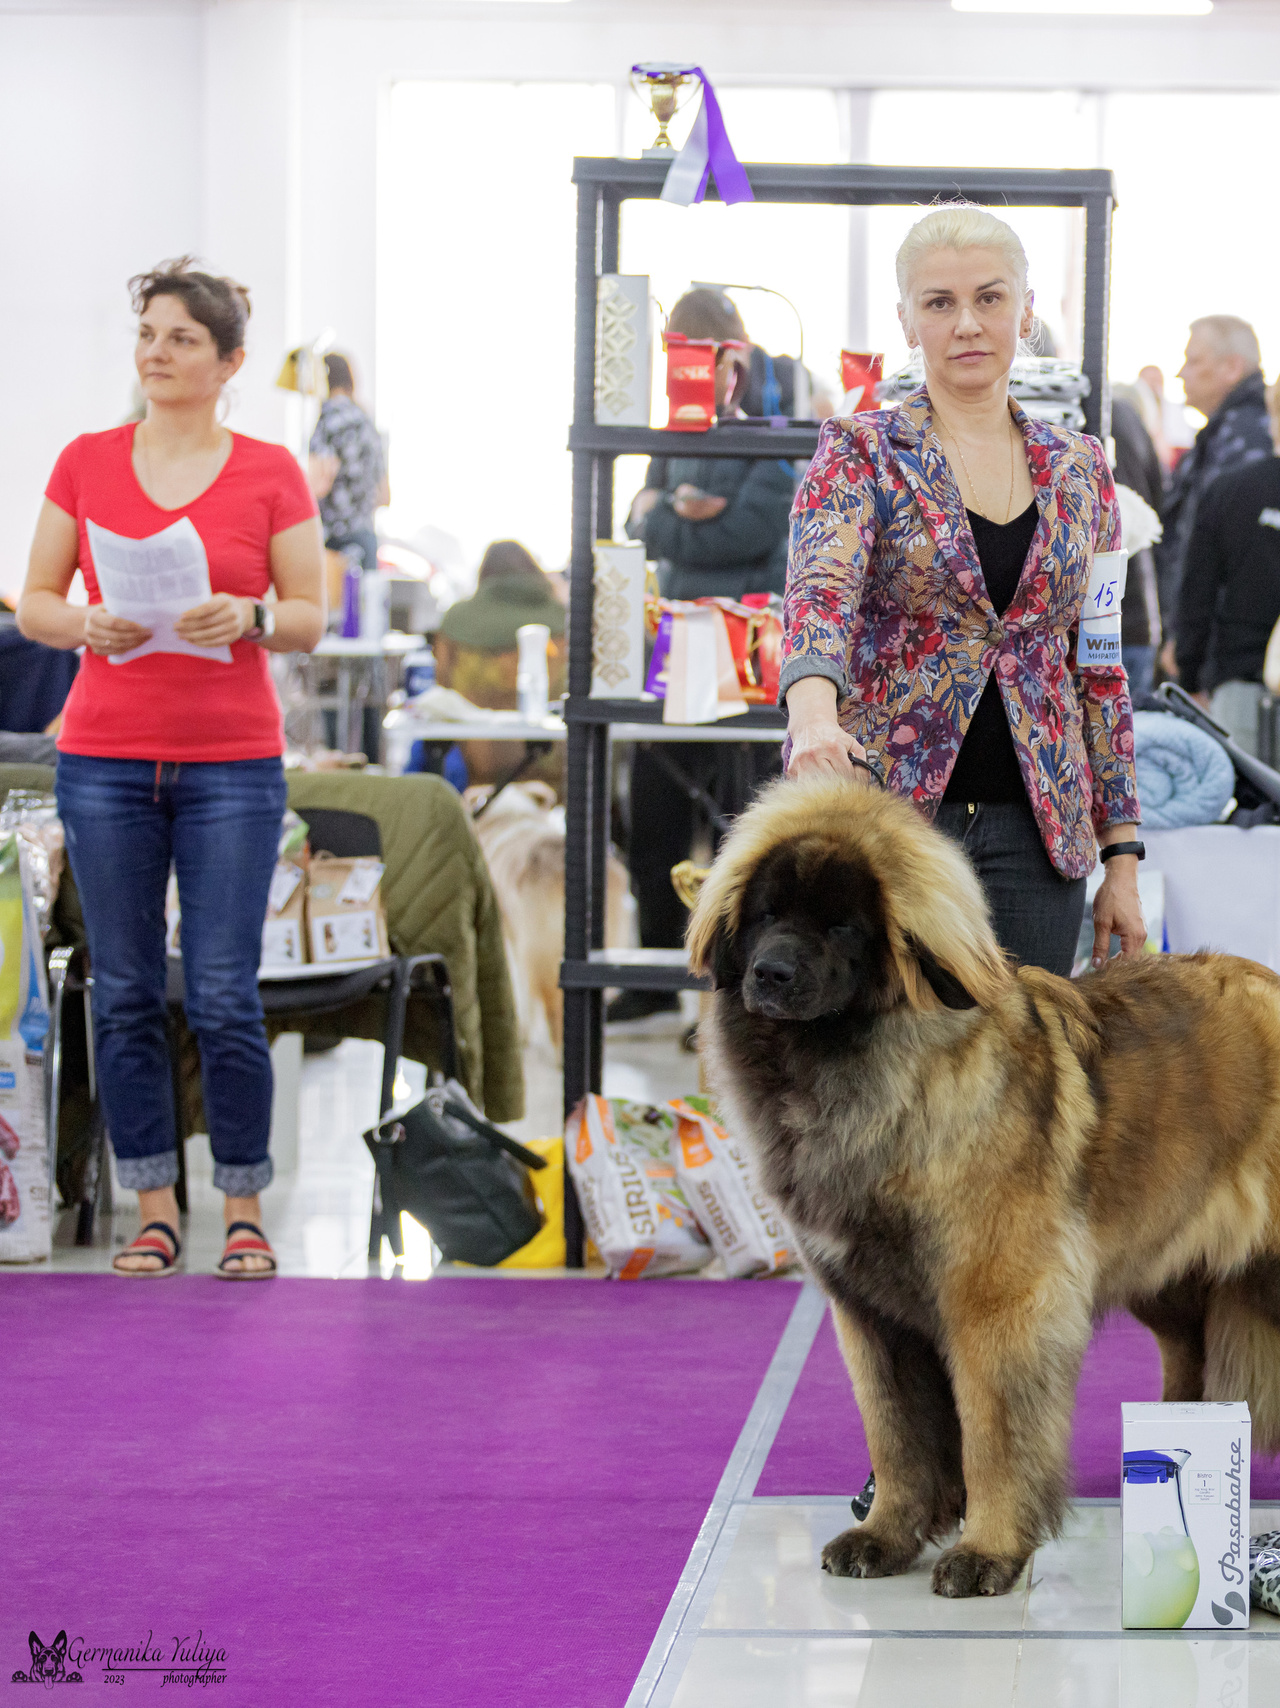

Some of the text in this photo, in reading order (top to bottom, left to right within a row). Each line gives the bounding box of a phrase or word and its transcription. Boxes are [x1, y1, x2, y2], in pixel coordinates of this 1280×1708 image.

[1094, 580, 1117, 608] 15
[614, 1151, 656, 1236] SIRIUS
[700, 1179, 739, 1248] SIRIUS
